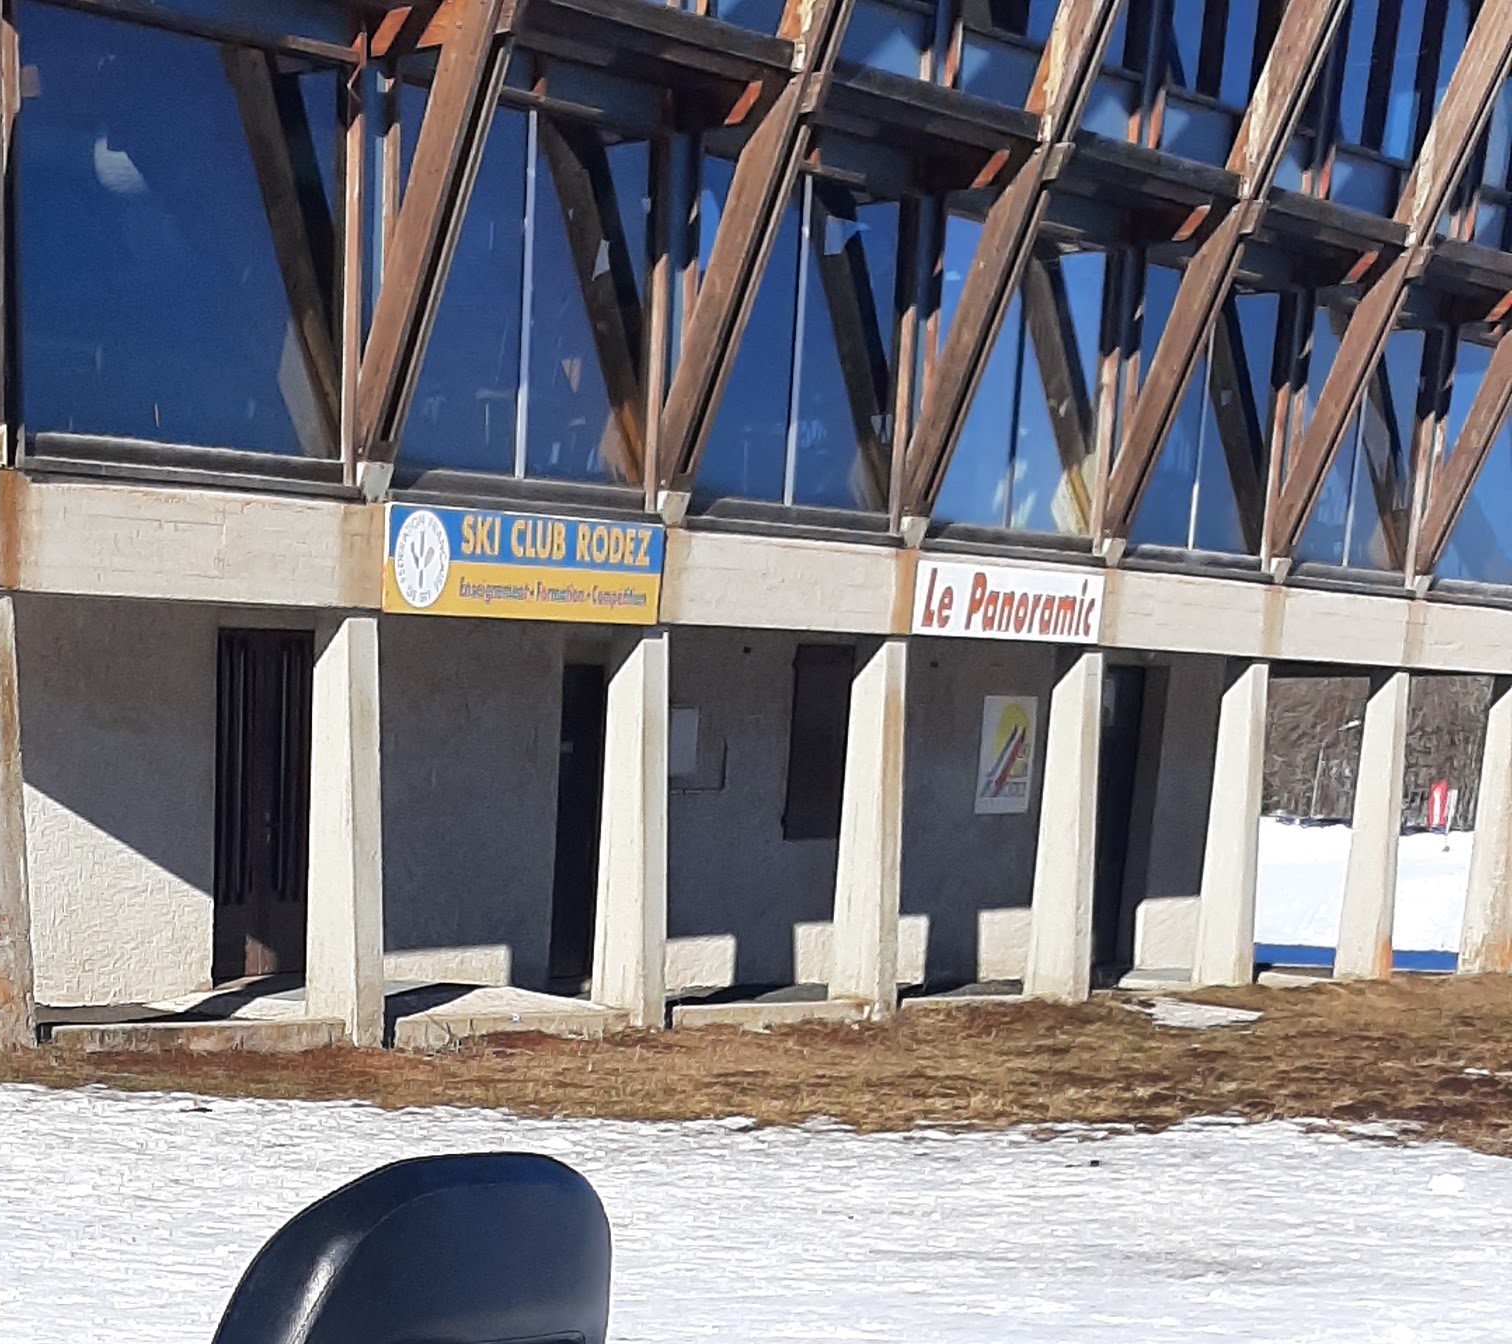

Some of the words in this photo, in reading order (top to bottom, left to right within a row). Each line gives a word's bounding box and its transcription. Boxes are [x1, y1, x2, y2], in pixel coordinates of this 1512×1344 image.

[461, 514, 501, 556] SKI
[511, 519, 566, 560] CLUB
[576, 523, 652, 566] RODEZ
[921, 567, 954, 628] Le
[964, 572, 1095, 637] Panoramic
